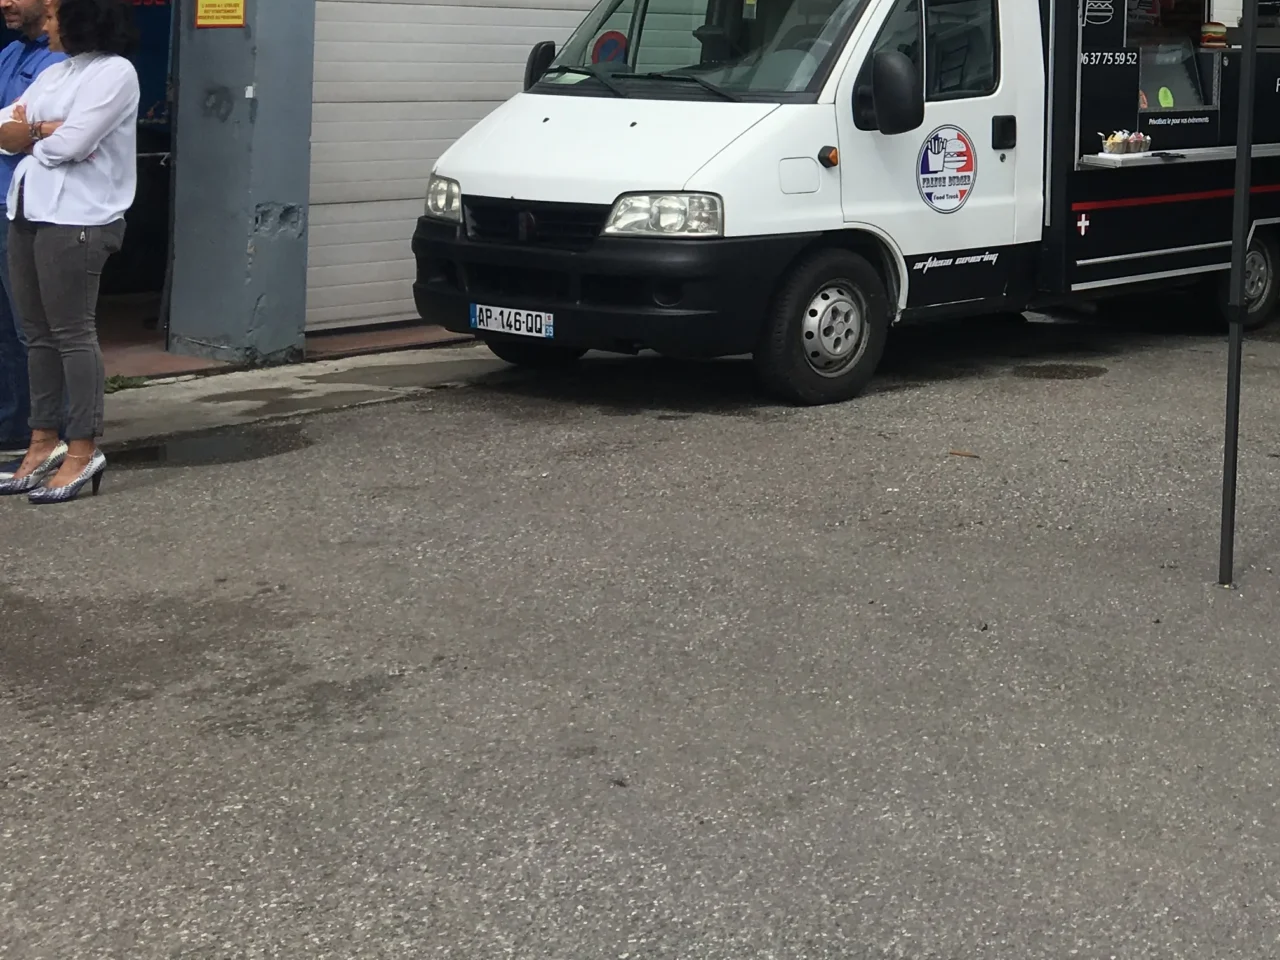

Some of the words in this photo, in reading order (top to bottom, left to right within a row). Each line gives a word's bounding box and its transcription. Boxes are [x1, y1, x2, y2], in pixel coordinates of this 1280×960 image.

[1090, 52, 1102, 65] 37
[1102, 52, 1113, 65] 75
[1114, 52, 1126, 65] 59
[1126, 52, 1138, 65] 52
[922, 176, 947, 188] FRENCH
[948, 175, 971, 186] BURGER
[946, 192, 959, 200] Truck
